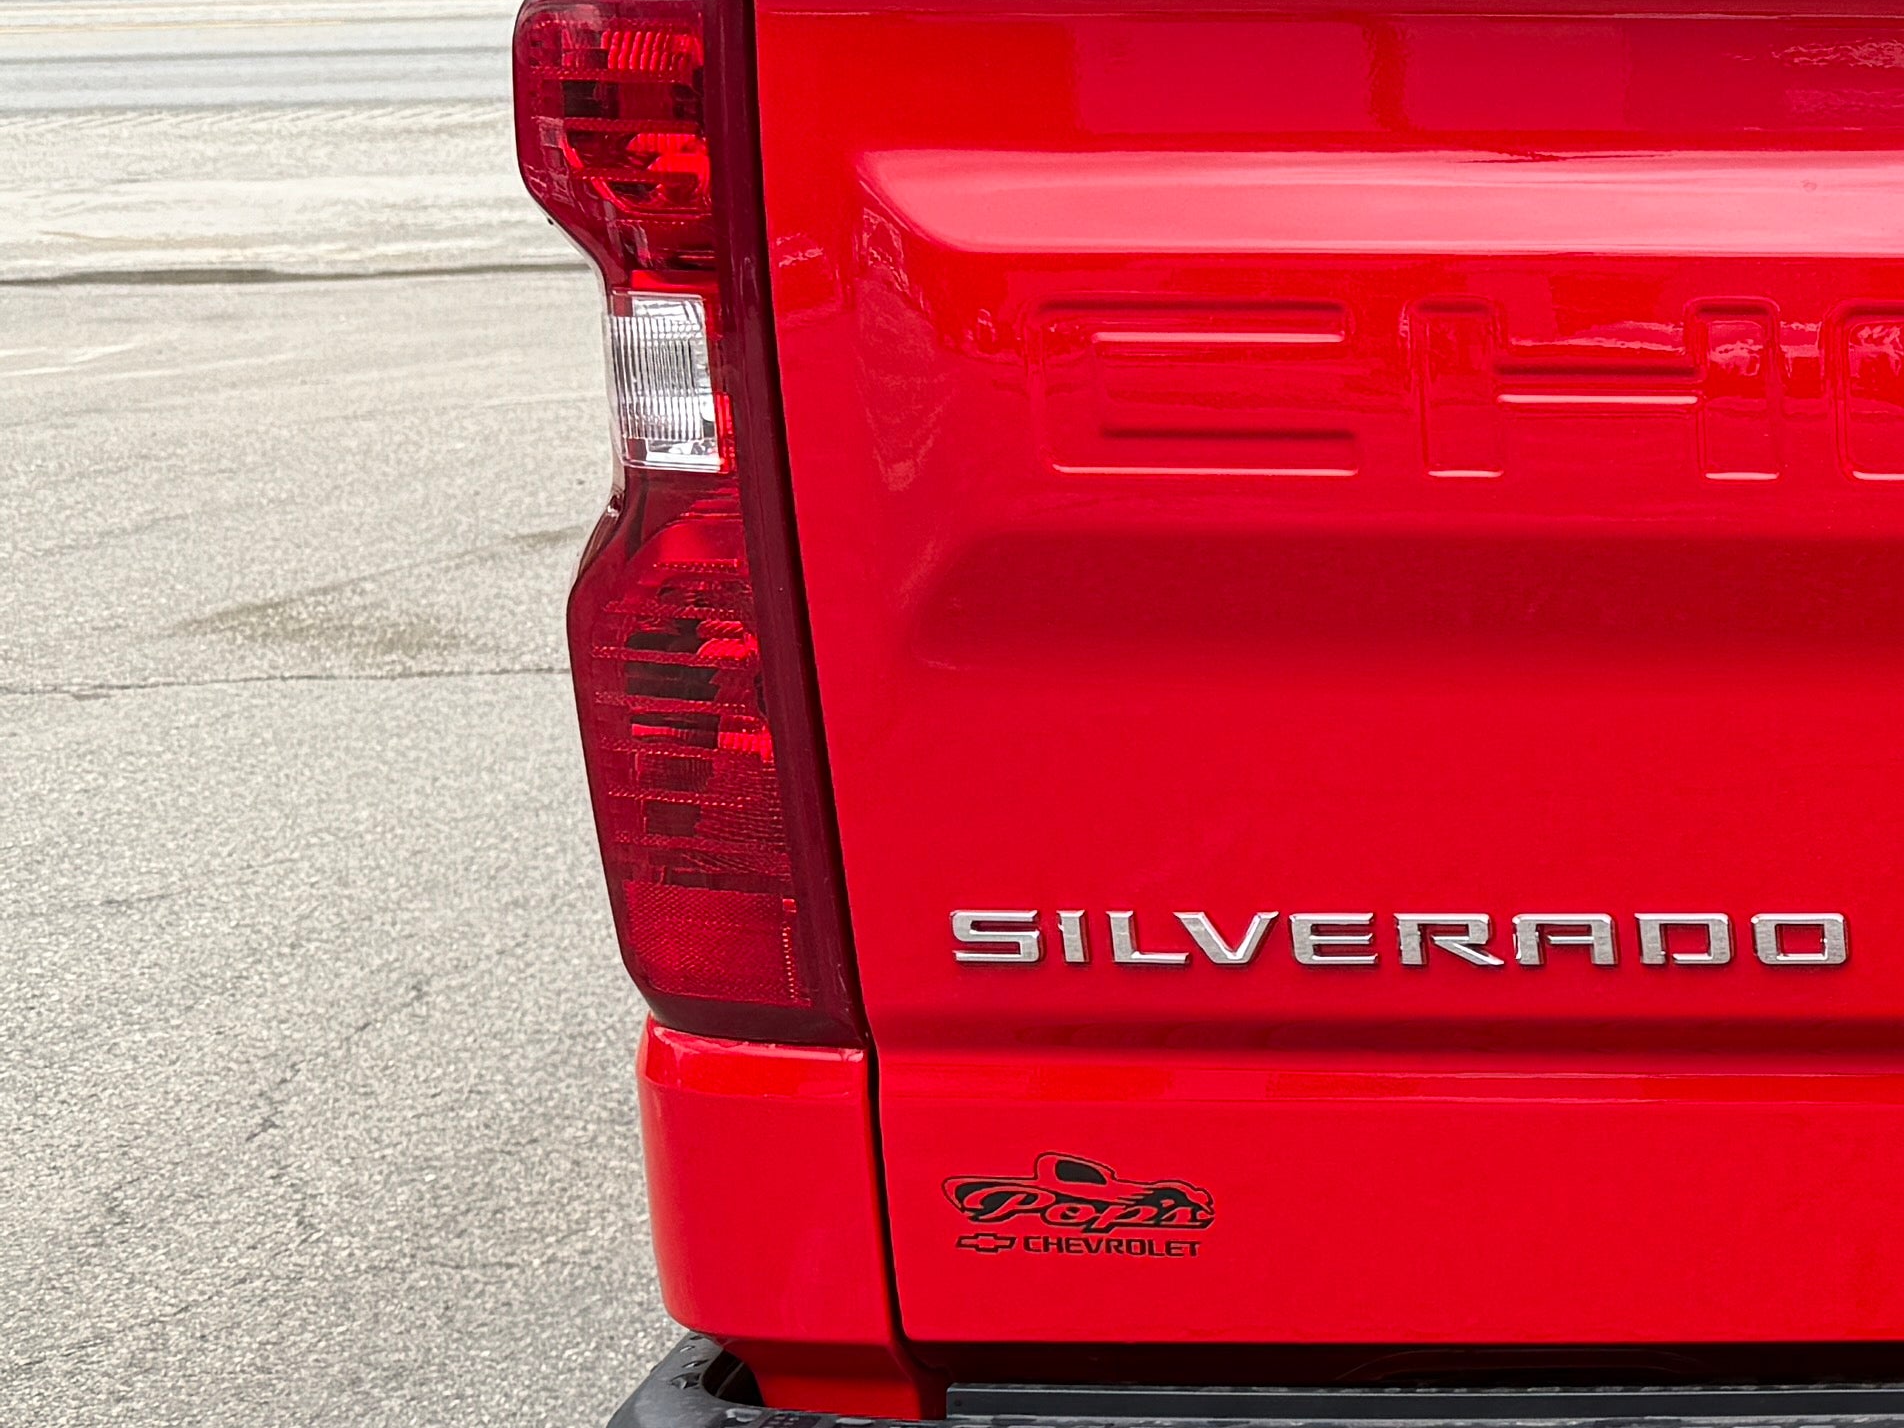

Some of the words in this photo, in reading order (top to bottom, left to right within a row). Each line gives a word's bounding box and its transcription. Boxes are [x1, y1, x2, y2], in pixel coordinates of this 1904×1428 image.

[950, 909, 1851, 968] SILVERADO
[962, 1183, 1206, 1232] Pop's
[1023, 1235, 1201, 1257] CHEVROLET
